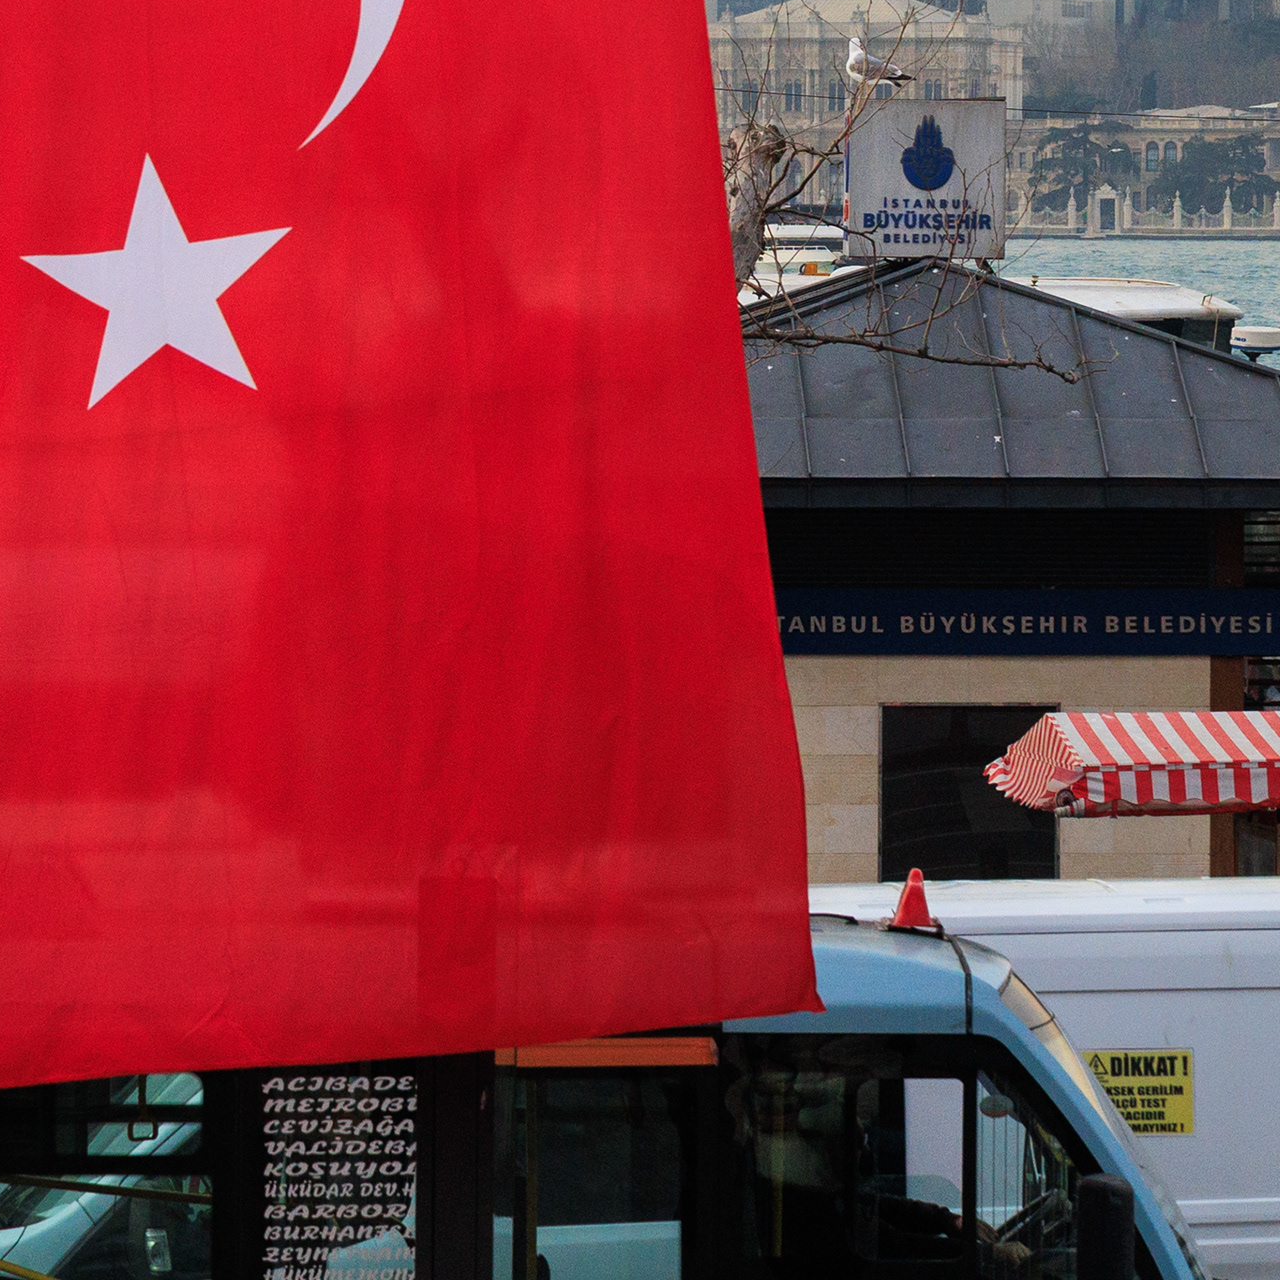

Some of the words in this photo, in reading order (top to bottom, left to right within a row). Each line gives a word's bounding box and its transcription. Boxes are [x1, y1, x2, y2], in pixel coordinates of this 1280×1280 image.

[884, 197, 971, 209] İSTANBUL
[863, 210, 992, 231] BÜYÜKŞEHİR
[1105, 612, 1273, 634] BELEDİYESİ
[1110, 1053, 1177, 1076] DİKKAT
[261, 1076, 418, 1094] ACIBADE
[1137, 1084, 1184, 1095] GERİLİM
[1140, 1098, 1167, 1108] TEST
[263, 1115, 414, 1136] CEVİZAĞA
[264, 1181, 354, 1199] ÜSKÜDAR
